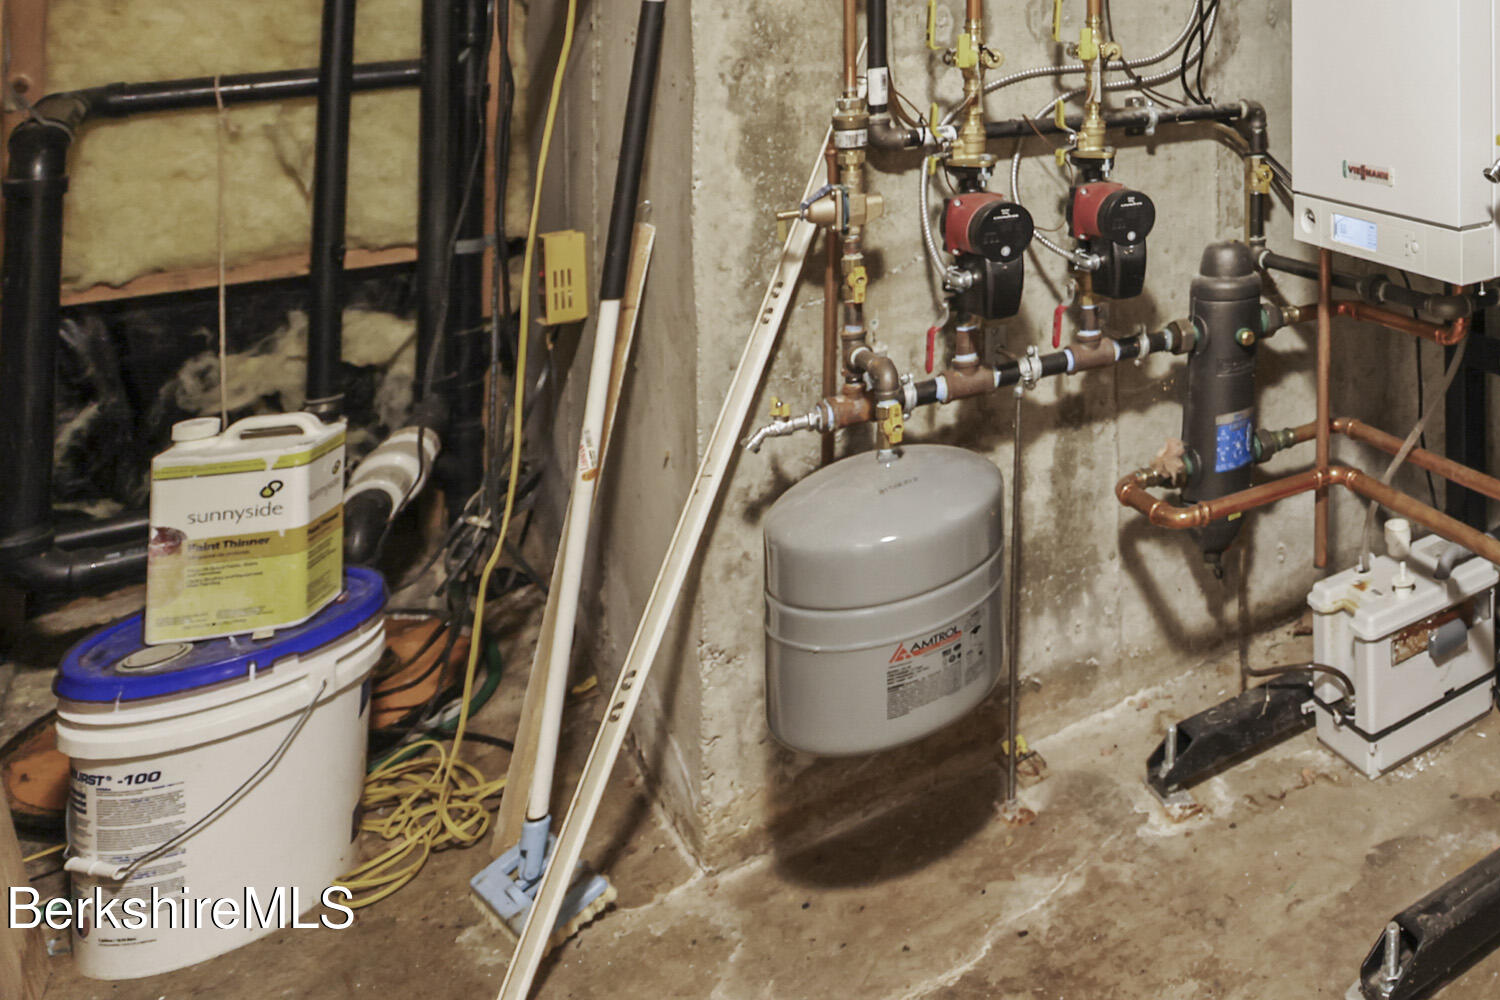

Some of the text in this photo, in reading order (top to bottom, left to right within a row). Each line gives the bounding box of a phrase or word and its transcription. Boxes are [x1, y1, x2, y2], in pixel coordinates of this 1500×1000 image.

[187, 502, 284, 525] sunnyside
[223, 537, 271, 549] Thinner
[910, 625, 960, 651] AMTROL
[117, 771, 161, 785] -100
